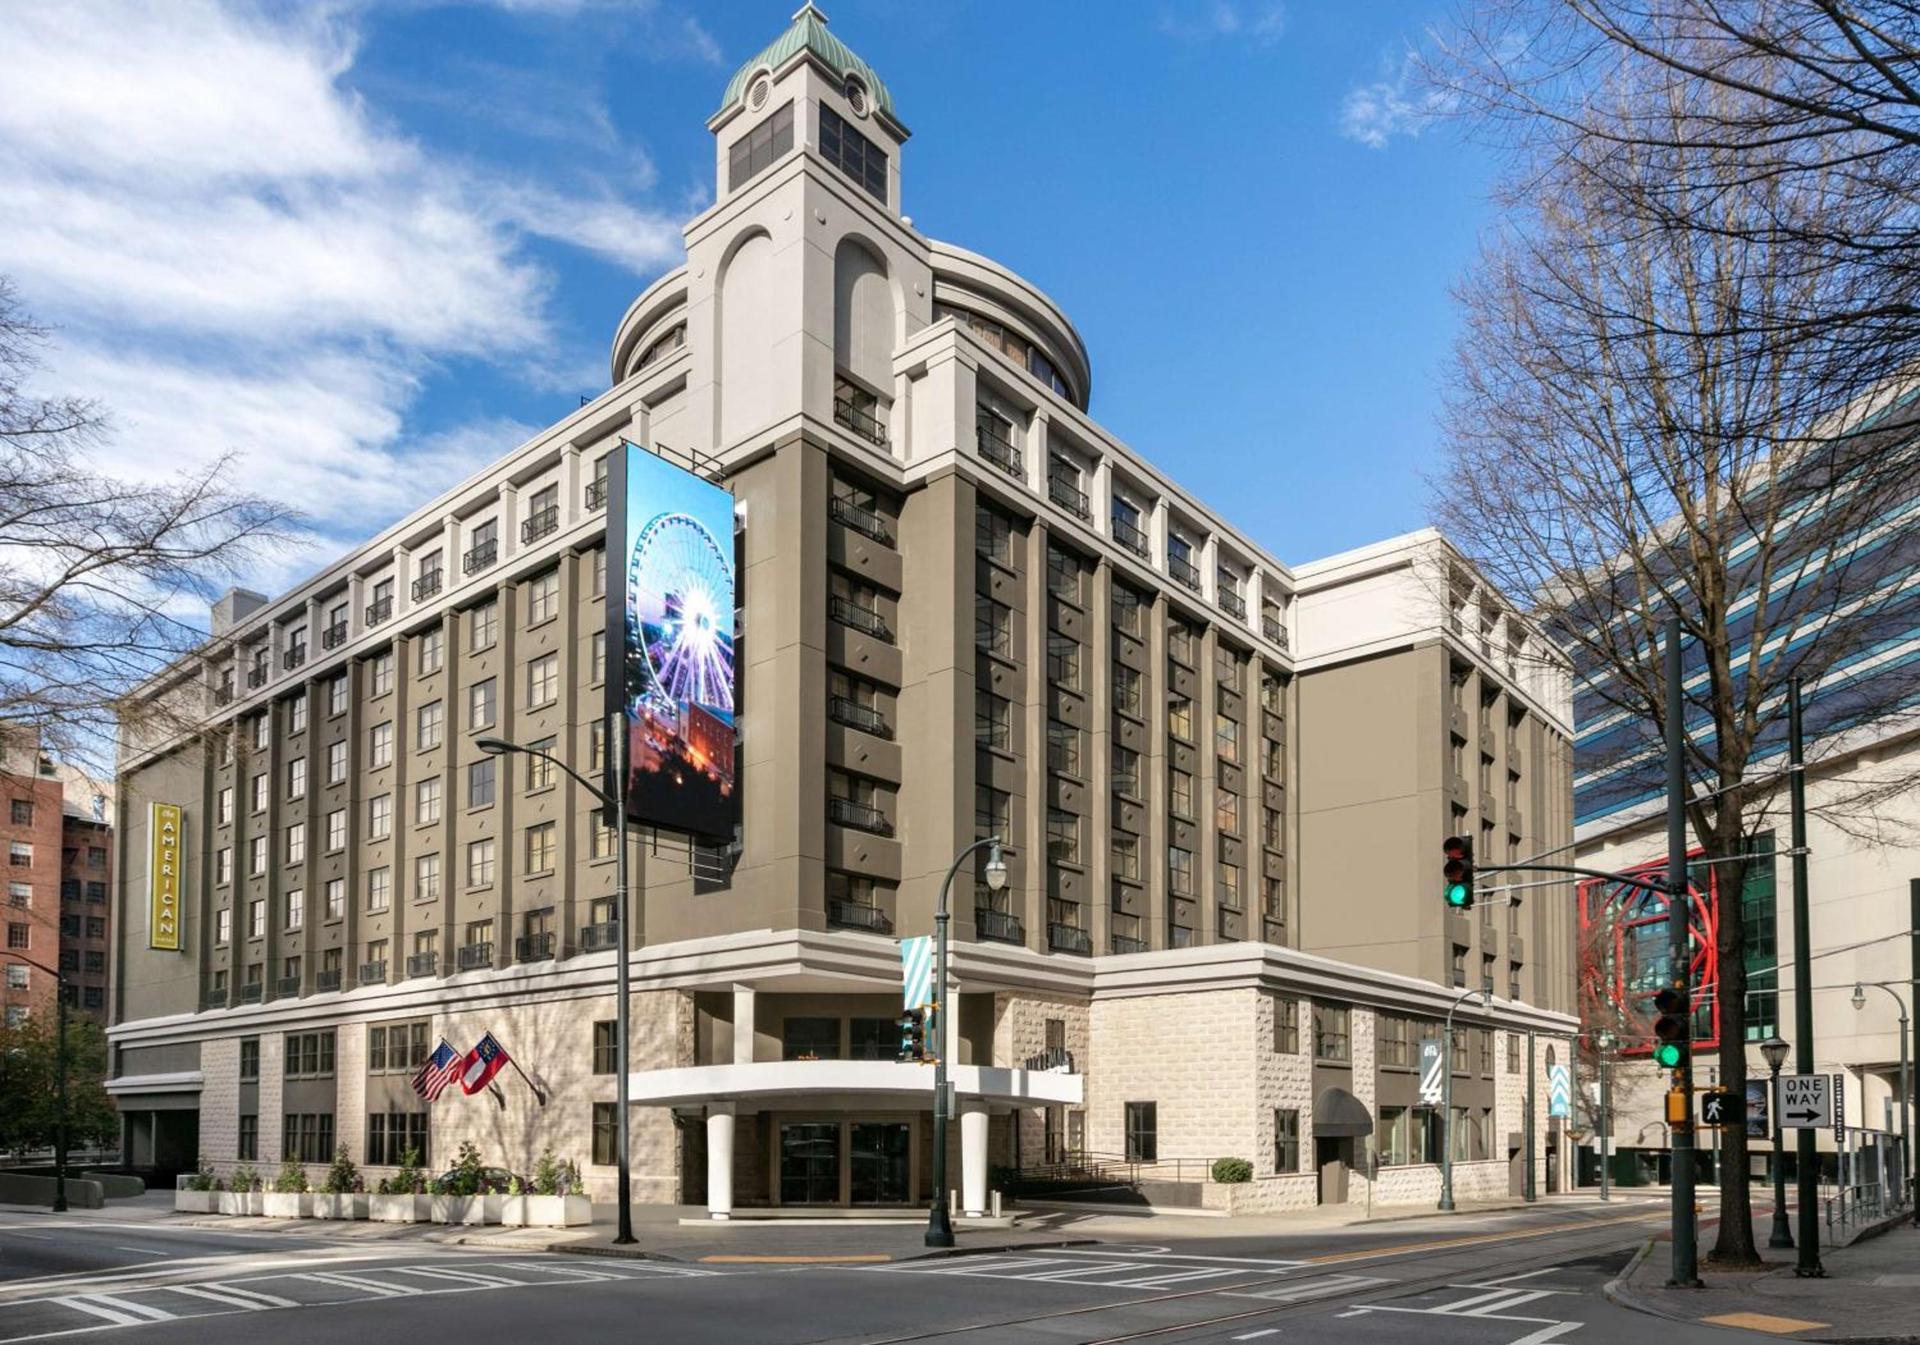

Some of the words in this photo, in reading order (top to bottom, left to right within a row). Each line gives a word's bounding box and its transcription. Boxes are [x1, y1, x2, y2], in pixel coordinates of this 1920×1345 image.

[160, 821, 175, 934] AMERICAN
[1786, 1079, 1822, 1091] ONE
[1785, 1093, 1821, 1105] WAY
